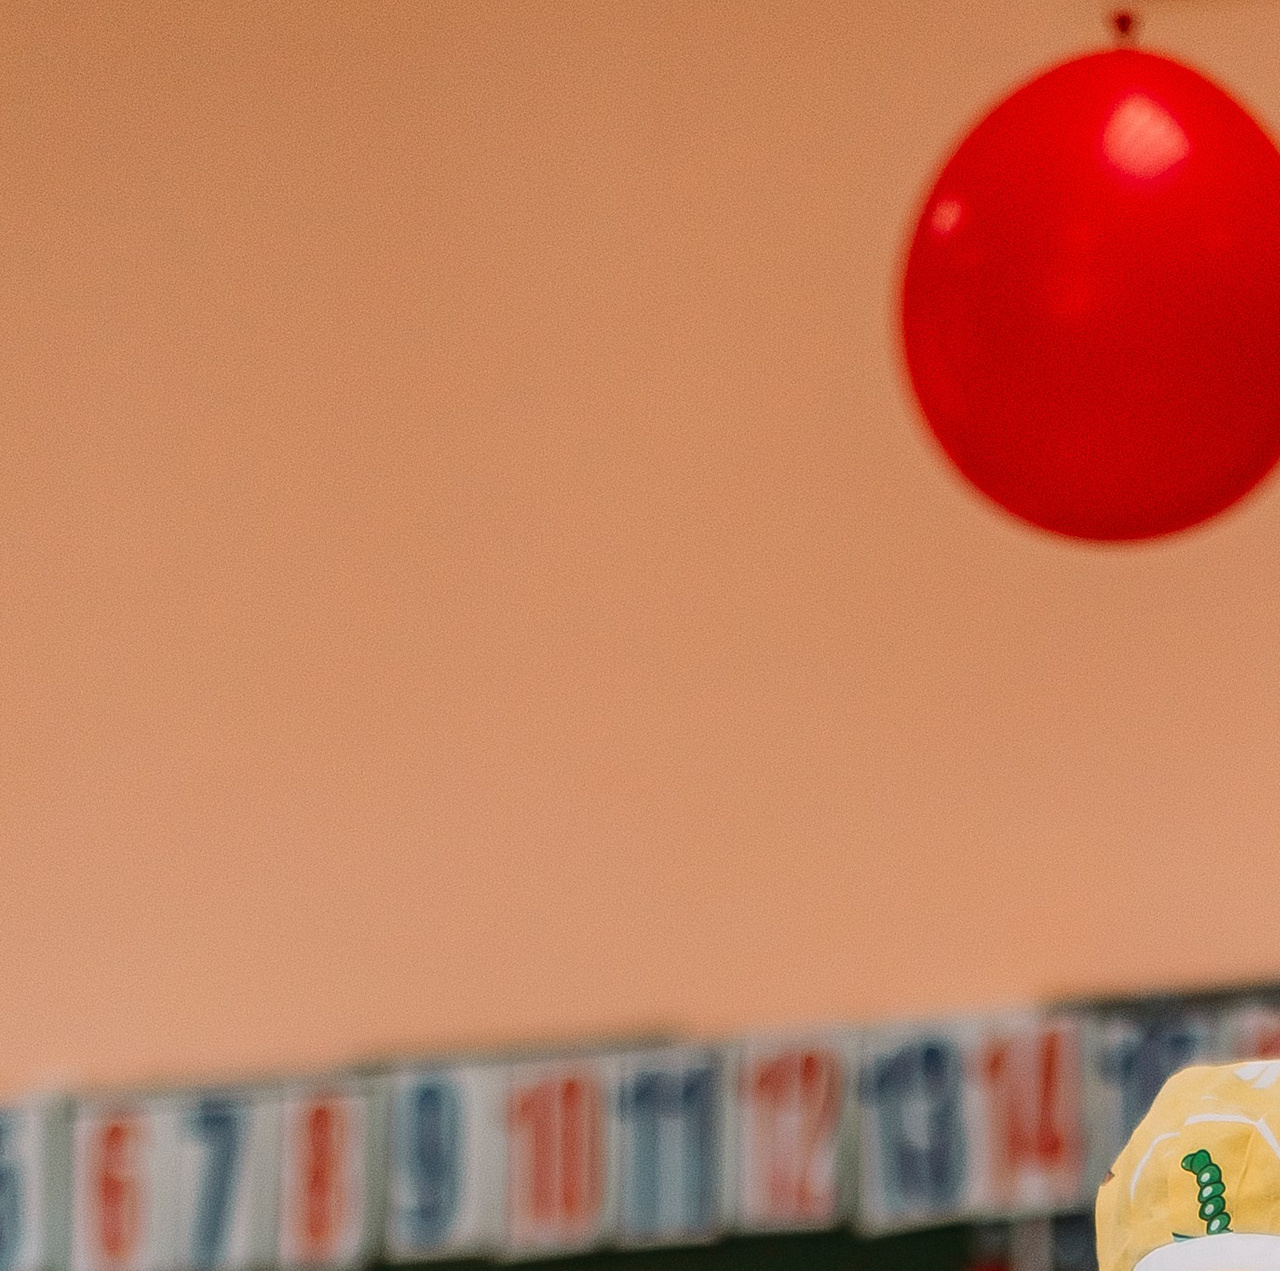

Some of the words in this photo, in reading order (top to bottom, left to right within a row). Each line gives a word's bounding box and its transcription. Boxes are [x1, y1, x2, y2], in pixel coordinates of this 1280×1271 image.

[400, 1074, 463, 1248] 9
[506, 1075, 603, 1238] 10
[615, 1066, 722, 1236] 11
[742, 1047, 841, 1218] 12
[857, 1040, 966, 1212] 13
[980, 1032, 1086, 1206] 14
